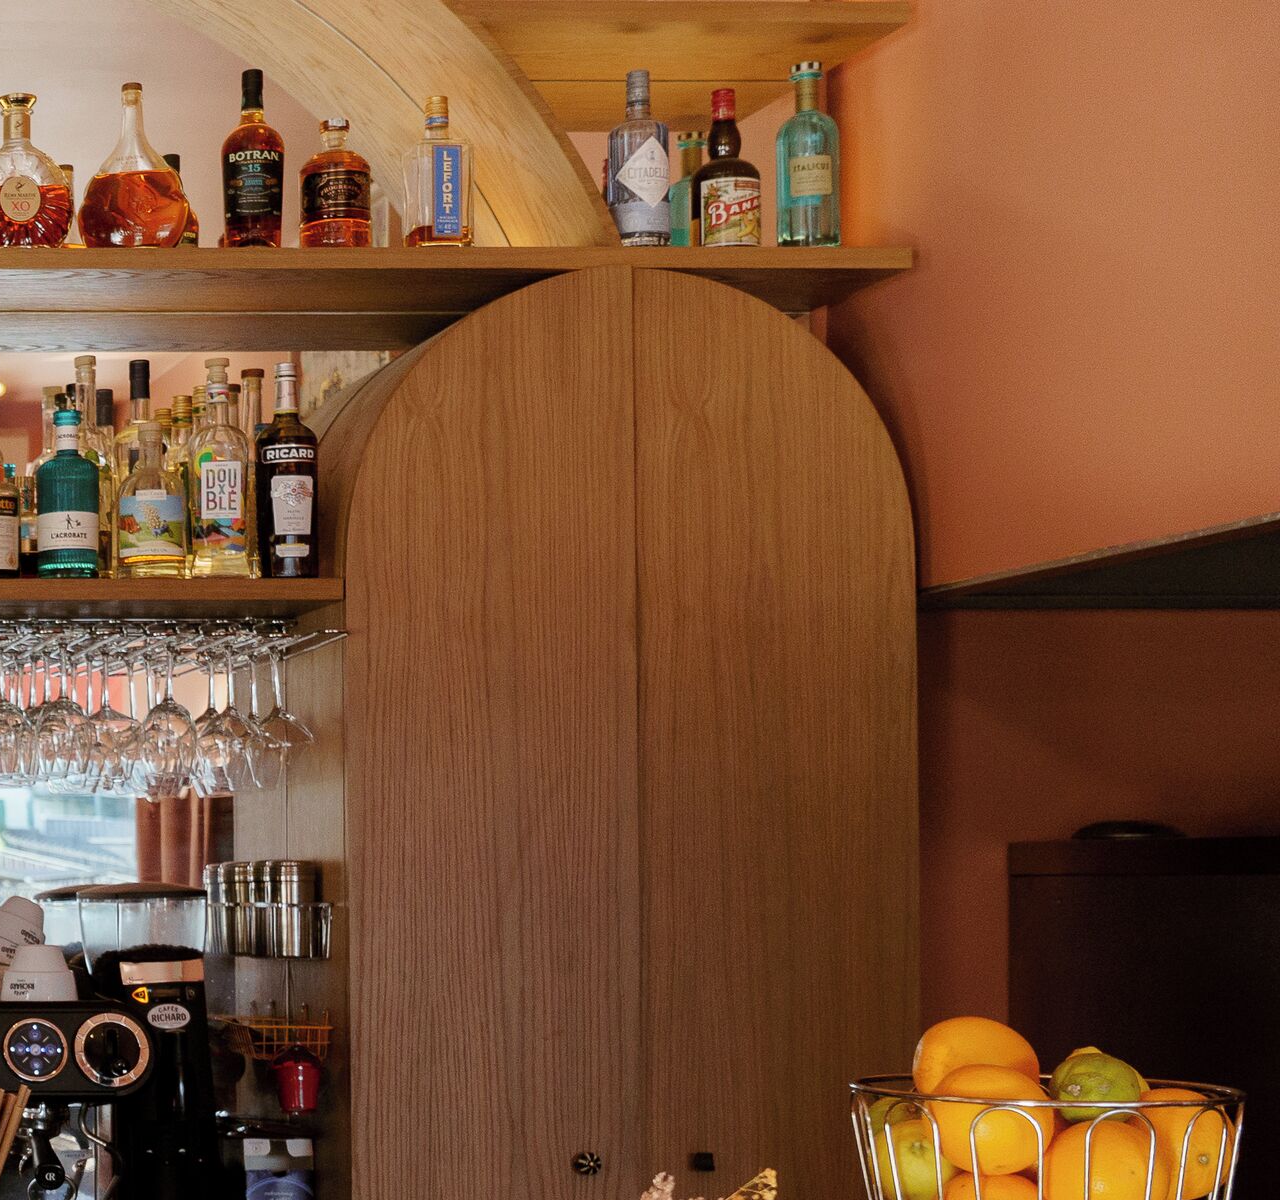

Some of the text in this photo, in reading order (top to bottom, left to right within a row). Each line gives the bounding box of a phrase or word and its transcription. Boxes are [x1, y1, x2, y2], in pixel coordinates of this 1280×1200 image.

[229, 150, 279, 163] BOTRAN
[247, 164, 260, 172] 15
[442, 150, 453, 213] LEFORT
[11, 202, 30, 210] XO
[266, 449, 315, 460] RICARD
[50, 532, 88, 540] L'ACROBATE
[151, 1011, 187, 1023] RICHARD
